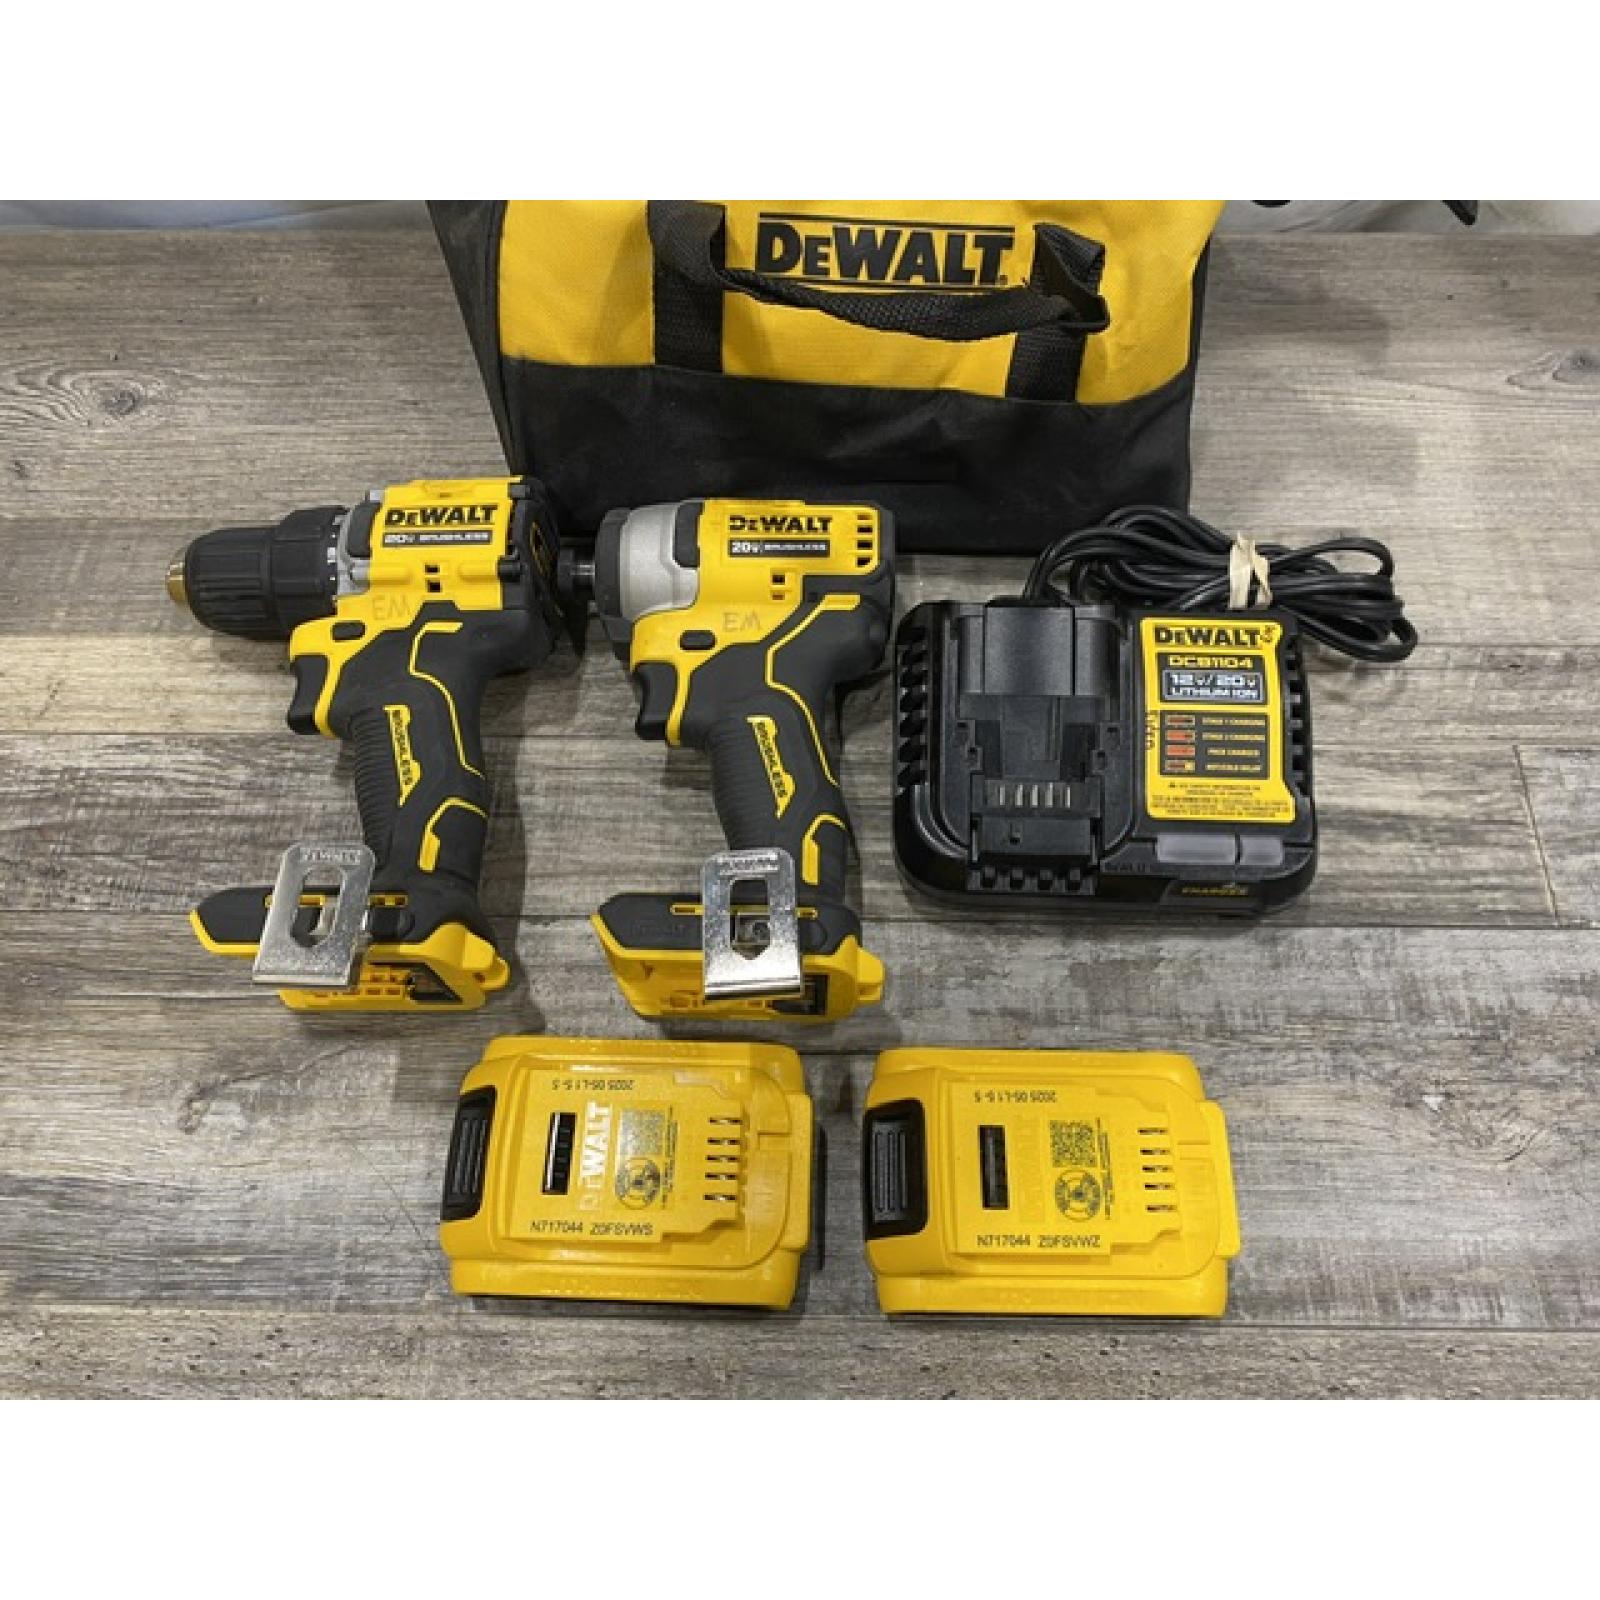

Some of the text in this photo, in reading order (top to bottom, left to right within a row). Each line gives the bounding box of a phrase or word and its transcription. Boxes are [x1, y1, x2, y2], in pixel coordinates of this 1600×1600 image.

[755, 221, 1014, 285] DEWALT
[385, 504, 498, 526] DEWALT
[729, 515, 833, 533] DEWALT
[731, 541, 761, 554] 20V
[1154, 626, 1261, 647] DEWALT
[1168, 655, 1254, 669] DCB1104
